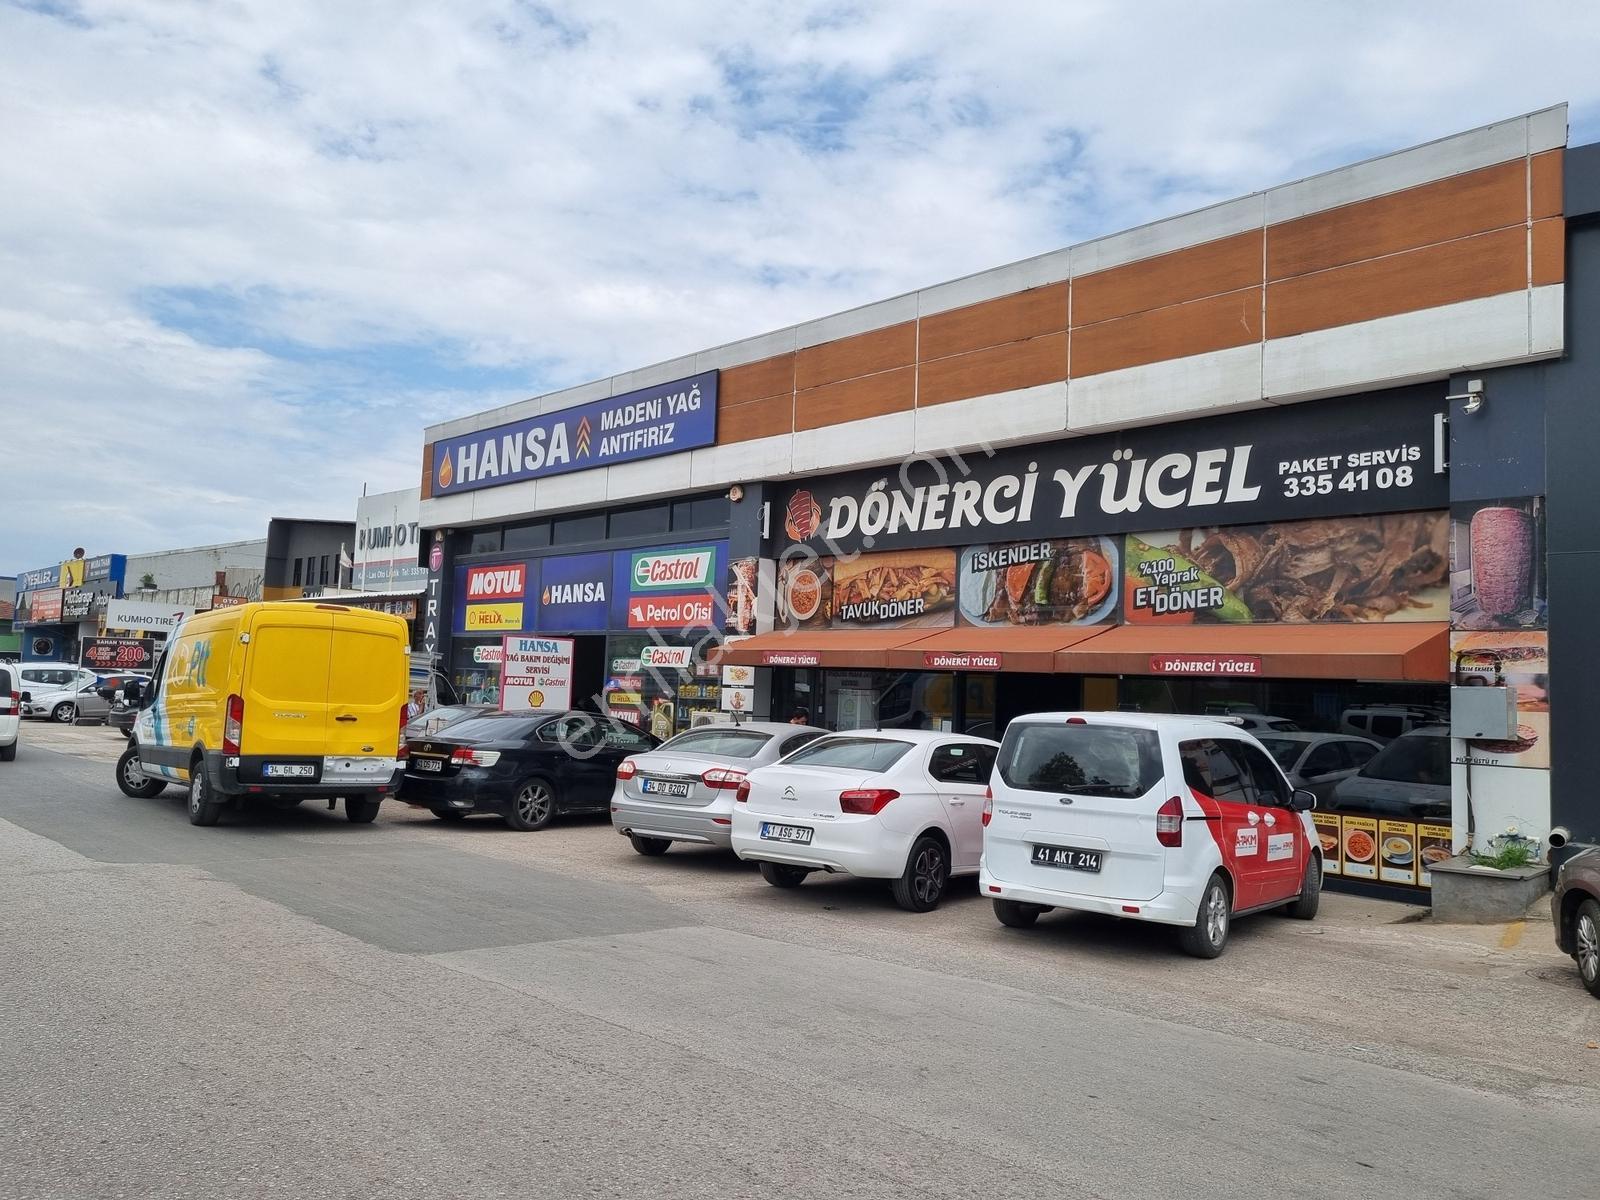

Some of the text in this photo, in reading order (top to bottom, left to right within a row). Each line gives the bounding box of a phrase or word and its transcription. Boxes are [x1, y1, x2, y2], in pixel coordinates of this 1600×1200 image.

[667, 383, 701, 415] YAĞ
[457, 423, 569, 484] HANSA
[1278, 443, 1421, 475] PAKET SERVİS
[1283, 465, 1414, 498] 335 41 08
[826, 444, 1262, 539] DÖNERCİ YÜCEL
[359, 524, 407, 551] KUMHO
[972, 541, 1051, 572] İSKENDER
[649, 556, 701, 582] Castrol
[1140, 558, 1175, 575] %100
[469, 569, 522, 595] MOTUL
[1153, 568, 1199, 586] Yaprak
[551, 582, 605, 604] HANSA
[1136, 586, 1223, 613] ET DÖNER
[479, 611, 502, 625] HELIX
[647, 601, 712, 622] Petrol Ofisi
[841, 598, 925, 621] TAVUK DÖNER
[117, 614, 174, 626] KUMHO TIRE
[86, 646, 97, 660] 4
[117, 645, 145, 662] 200
[519, 640, 559, 654] HANSA
[520, 654, 541, 663] BAKIM
[652, 650, 685, 664] Castrol
[769, 655, 818, 665] DÖNERCİ YÜCEL
[933, 656, 998, 667] DÖNERCİ YÜCEL
[1164, 659, 1256, 673] DÖNERCİ YÜCEL
[506, 677, 566, 687] MOTUL Castrol
[269, 766, 313, 775] 34 GIL 250
[647, 781, 656, 791] 34
[778, 828, 793, 838] ASG
[796, 830, 811, 841] 571
[1038, 848, 1050, 861] 41
[1054, 850, 1074, 864] AKT
[1078, 853, 1097, 868] 214
